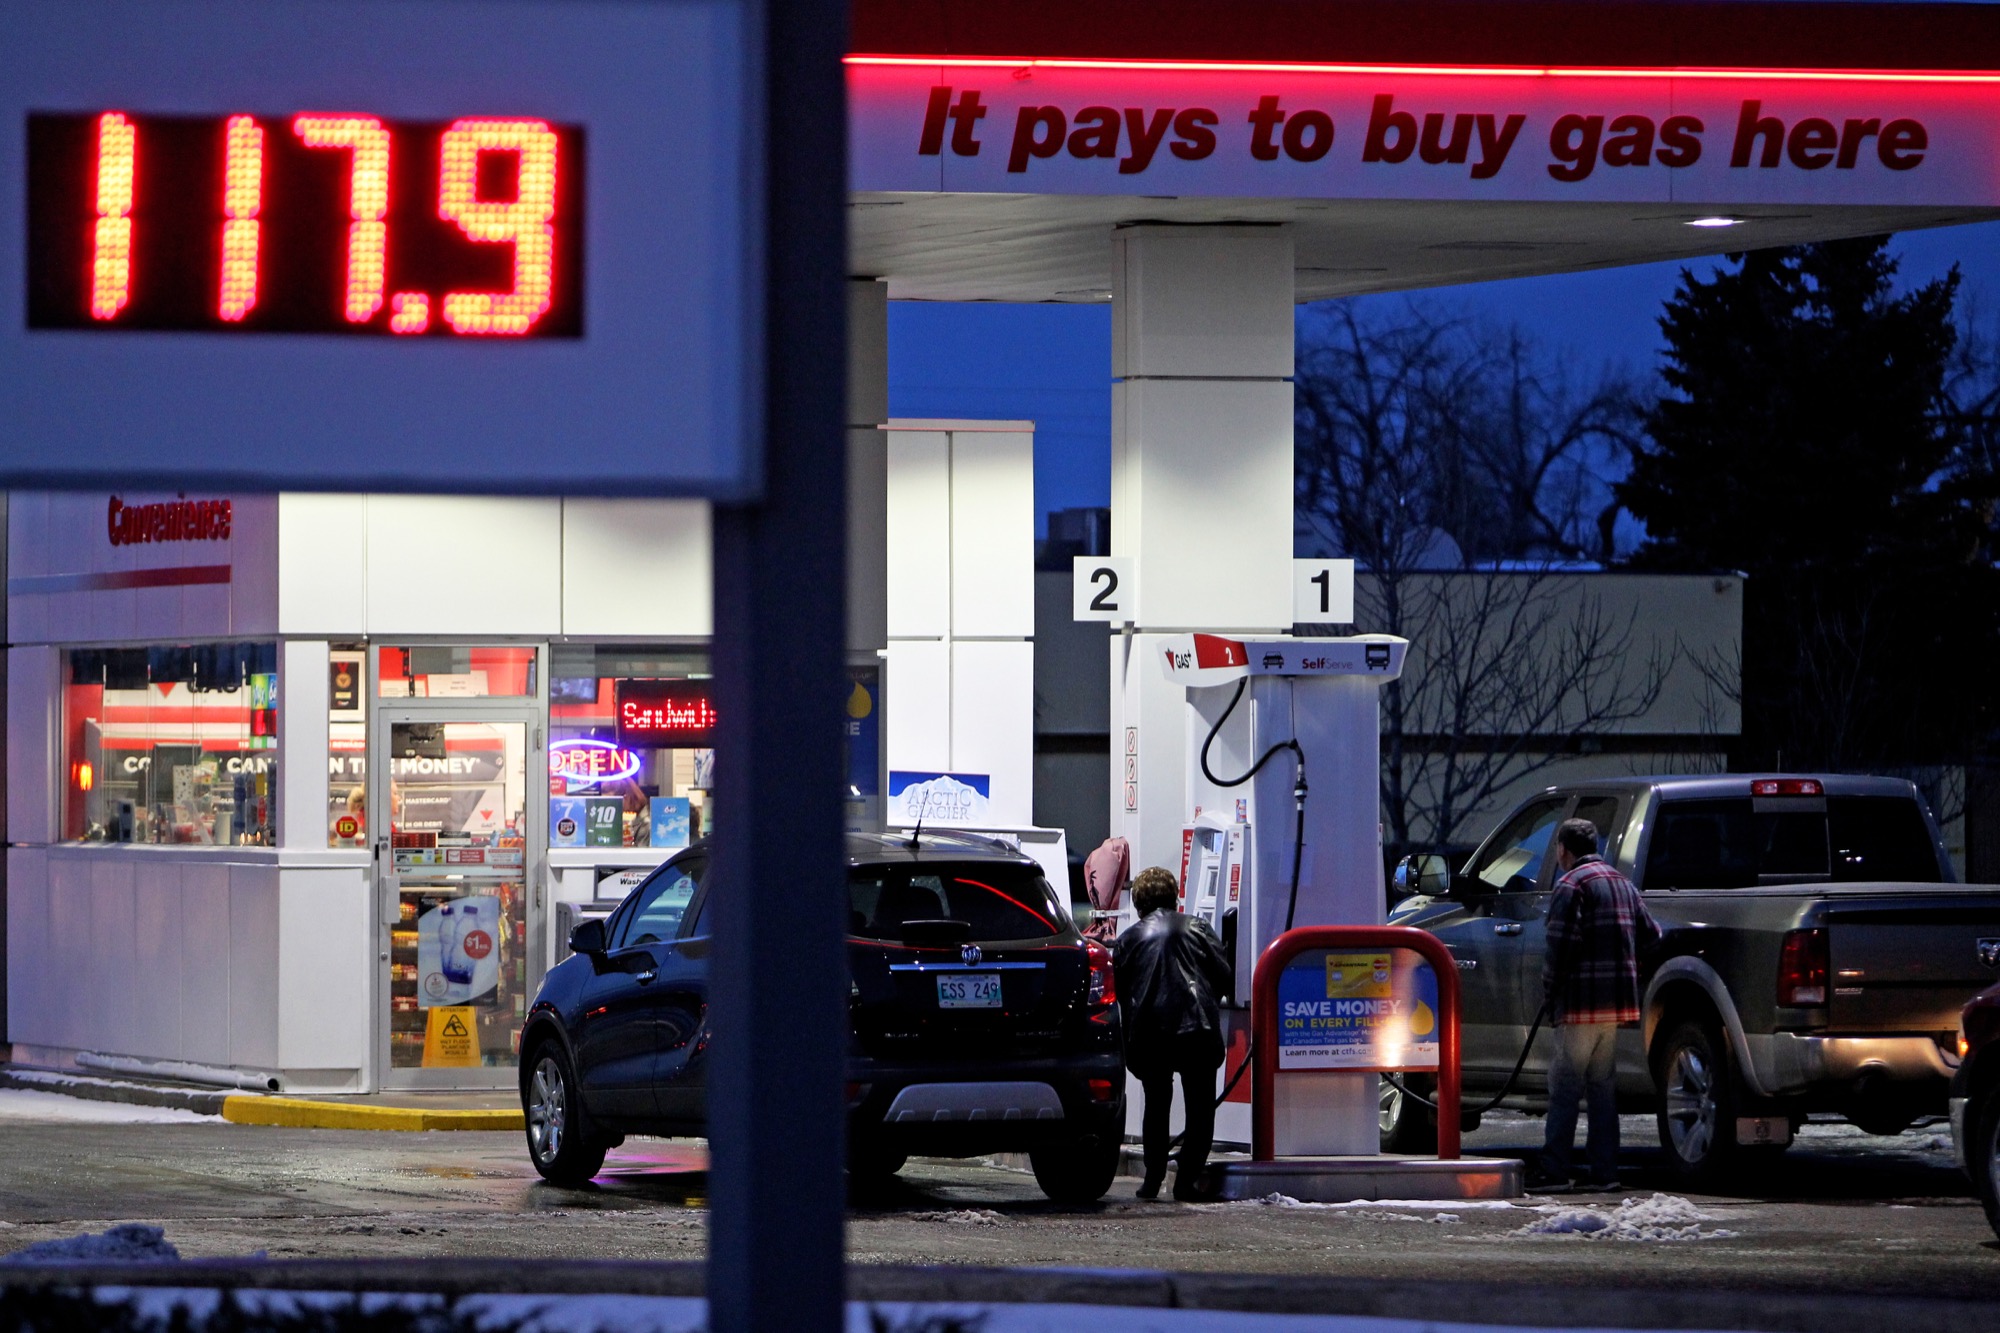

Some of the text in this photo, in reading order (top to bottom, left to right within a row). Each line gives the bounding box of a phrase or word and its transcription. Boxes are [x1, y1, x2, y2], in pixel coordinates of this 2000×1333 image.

[918, 86, 1929, 182] It pays to buy gas here
[92, 112, 557, 333] 117.9
[108, 490, 231, 546] Convenience
[1089, 567, 1119, 612] 2
[1311, 569, 1330, 612] 1
[1225, 647, 1234, 664] 2
[548, 749, 628, 772] OPEN
[907, 788, 972, 807] ARCTIC
[590, 805, 616, 824] $10
[908, 805, 970, 820] GLACIER
[339, 823, 355, 833] ID
[620, 878, 642, 886] Wash
[941, 982, 998, 999] ESS 249
[1284, 1000, 1402, 1016] SAVE MONEY
[1284, 1018, 1304, 1029] ON
[1311, 1018, 1351, 1028] EVERY
[1285, 1049, 1307, 1057] Learn
